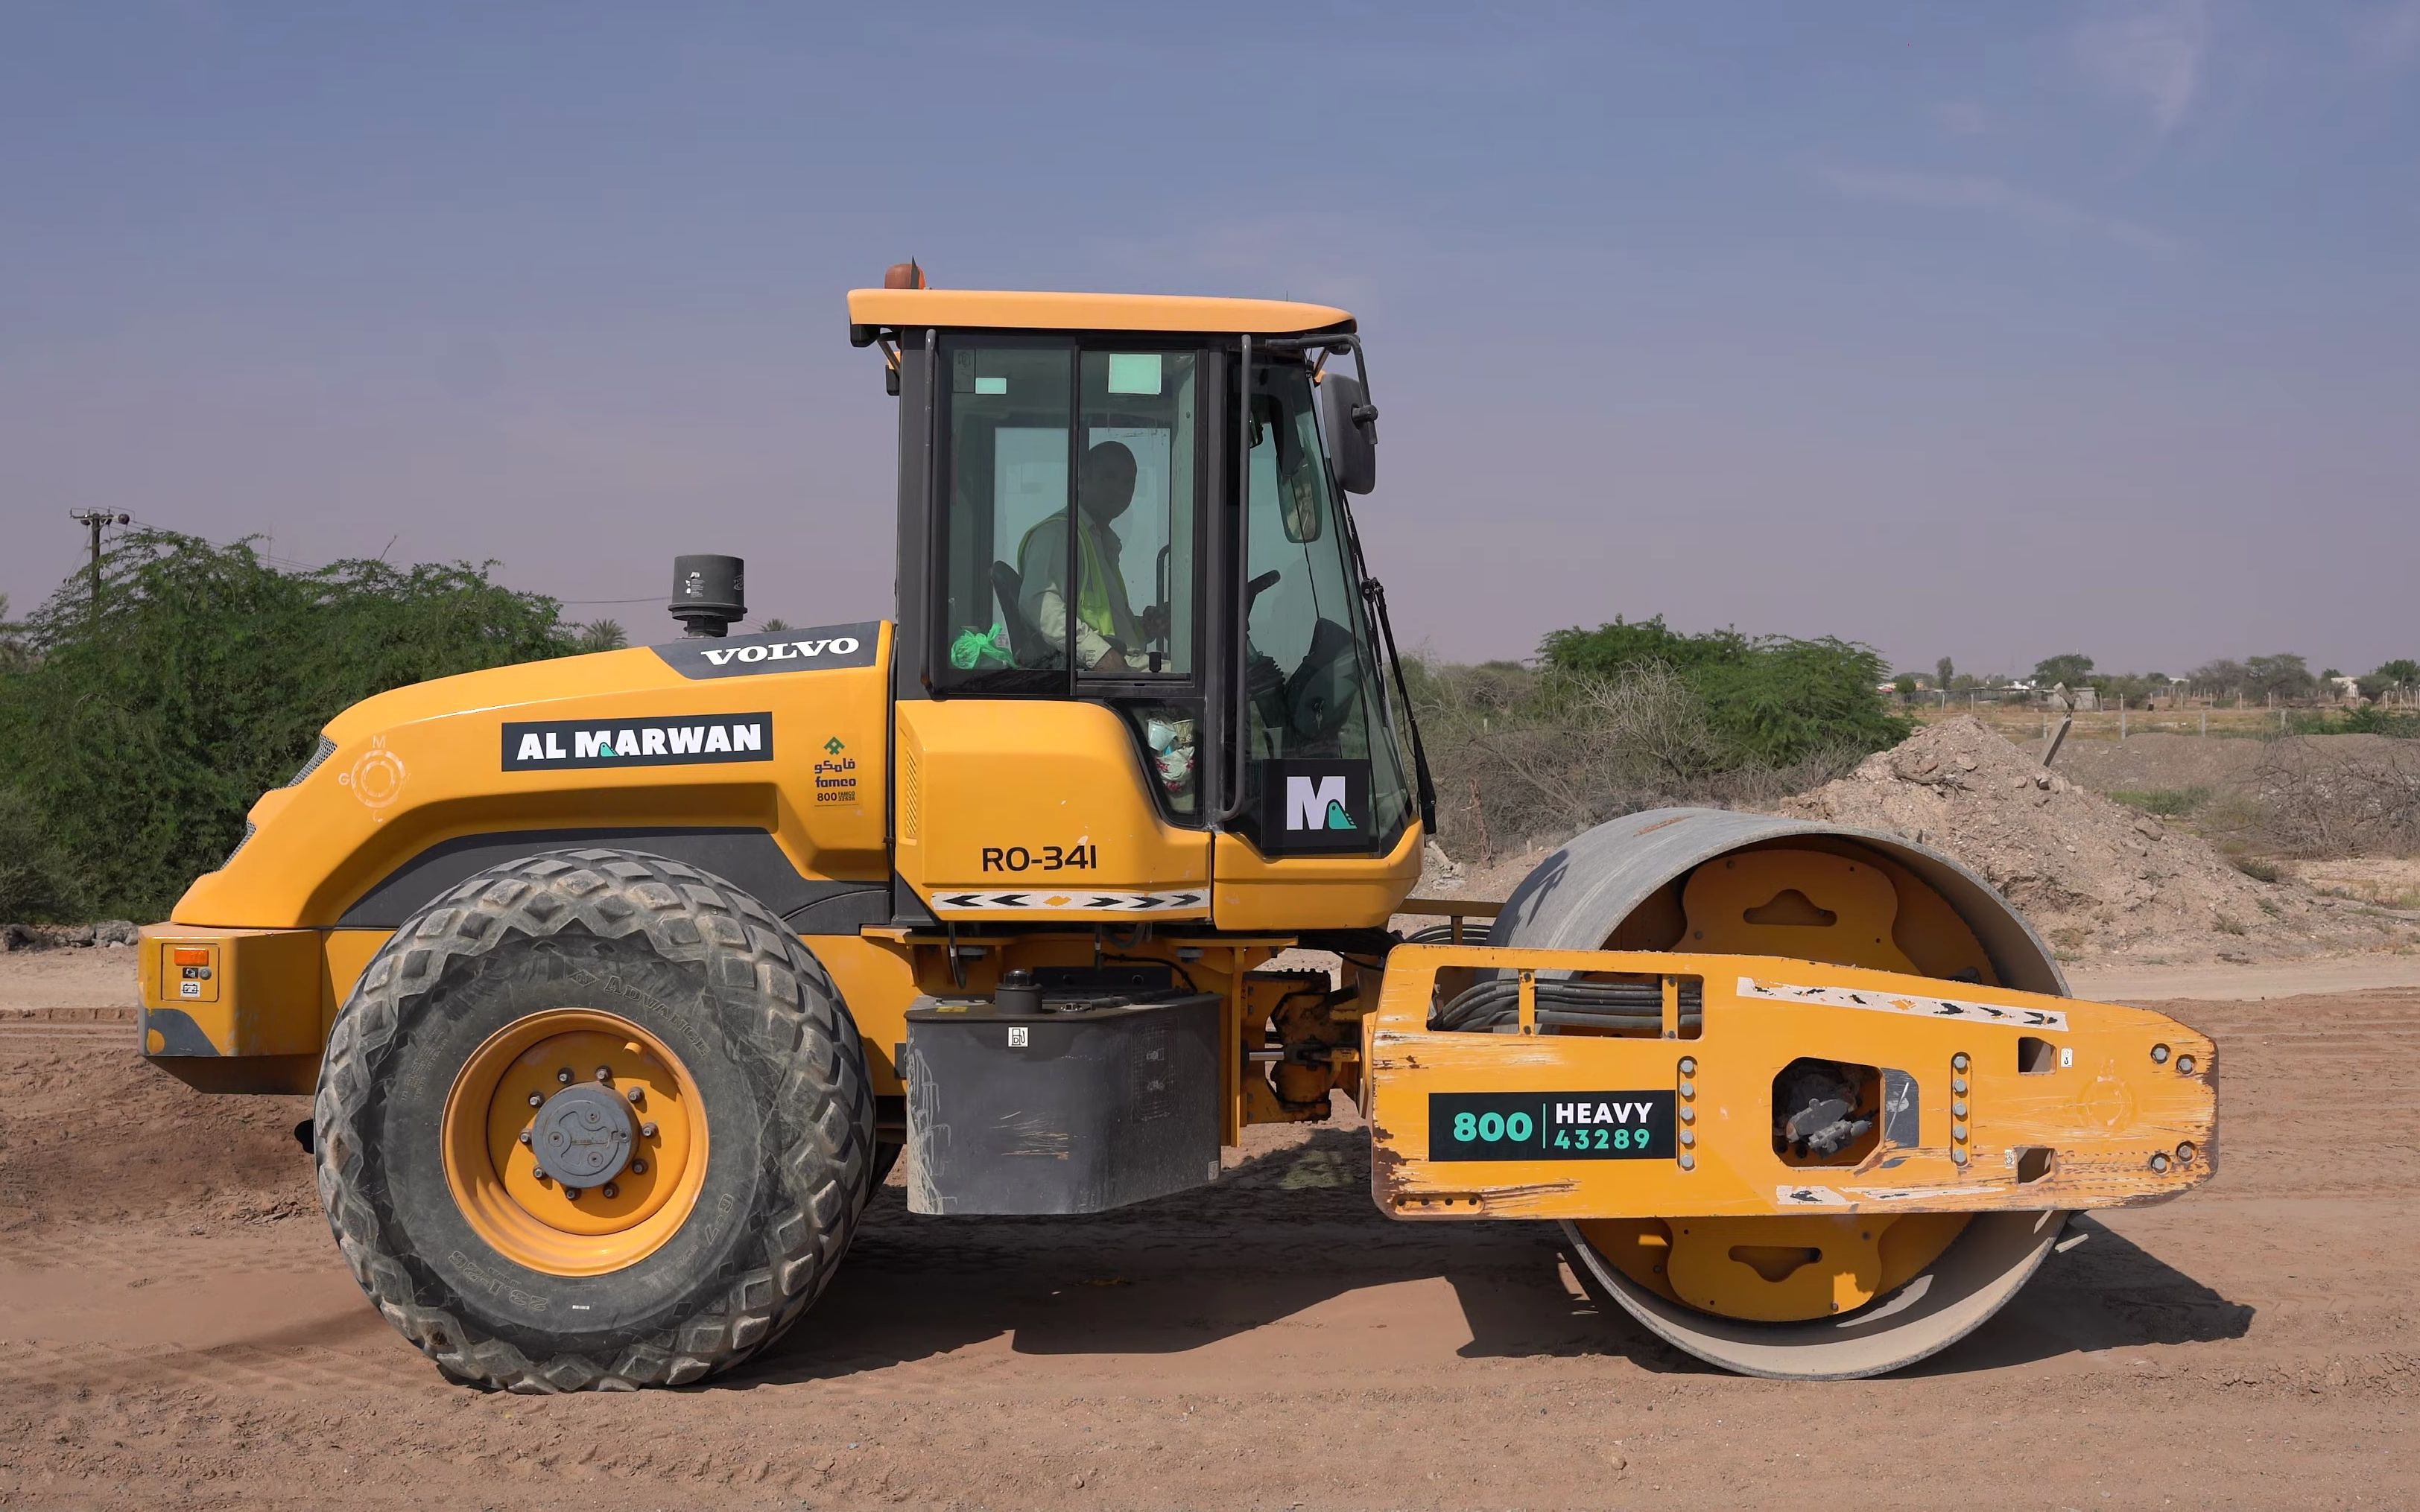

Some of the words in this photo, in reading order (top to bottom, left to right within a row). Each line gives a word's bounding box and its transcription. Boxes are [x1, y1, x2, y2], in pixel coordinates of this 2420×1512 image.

[701, 637, 859, 665] VOLVO
[516, 732, 566, 760] AL
[574, 723, 761, 758] MARWAN
[814, 757, 855, 774] فامكو
[815, 776, 856, 787] famco
[817, 792, 837, 802] 800
[1287, 776, 1346, 830] M
[604, 975, 711, 1057] ADVANCE
[1454, 1111, 1533, 1142] 800
[1556, 1102, 1653, 1124] HEAVY
[1553, 1128, 1650, 1149] 43289
[449, 1251, 549, 1312] 23.1-26
